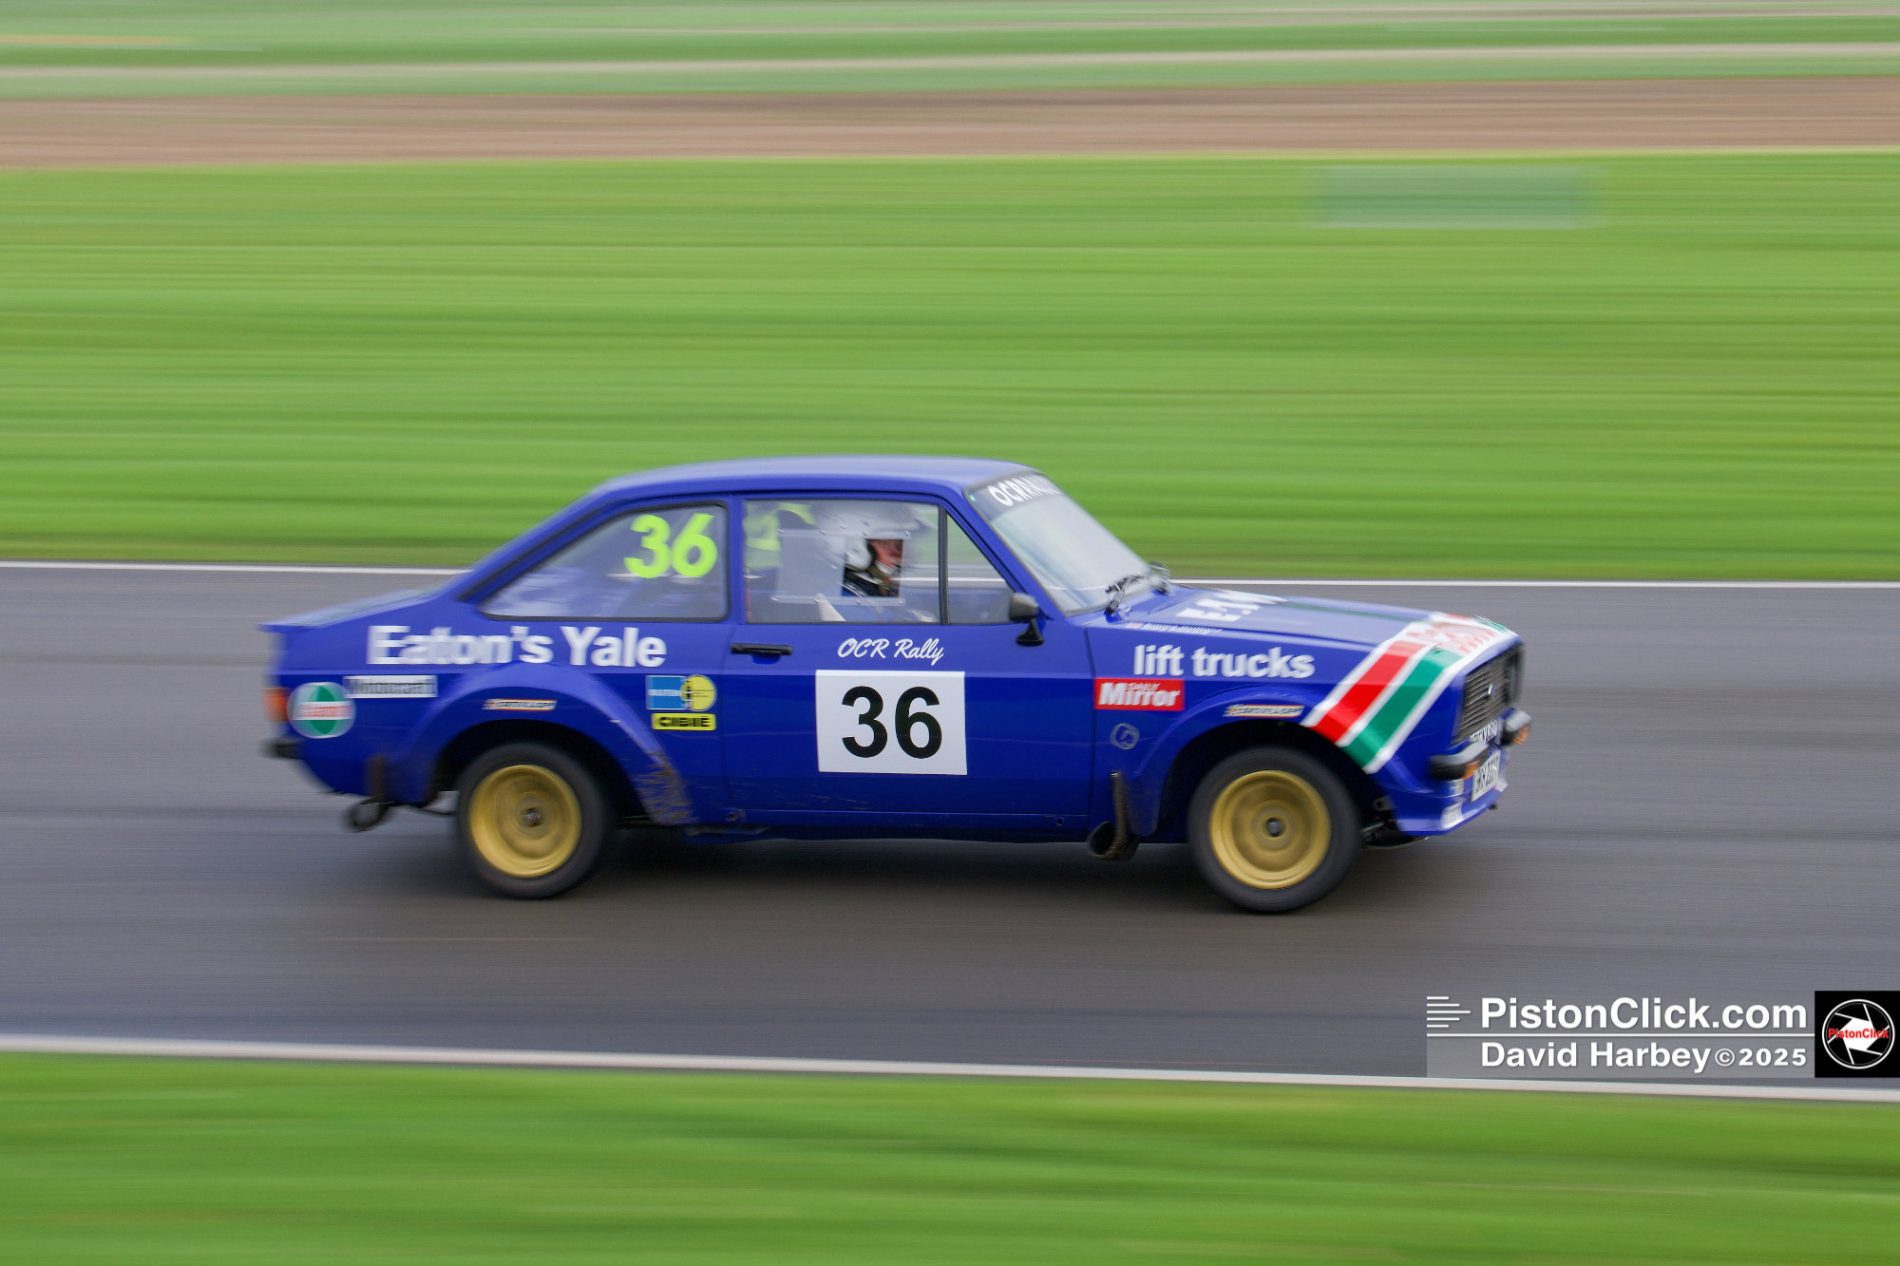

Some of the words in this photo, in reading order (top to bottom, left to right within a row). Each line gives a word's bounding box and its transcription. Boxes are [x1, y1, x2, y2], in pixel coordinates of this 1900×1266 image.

[624, 512, 718, 579] 36
[366, 625, 553, 665] Eaton's
[560, 626, 667, 668] Yale
[837, 637, 887, 660] OCR
[893, 637, 944, 666] Rally
[1133, 644, 1184, 677] lift
[1192, 646, 1316, 679] trucks
[1098, 682, 1181, 706] Mirror
[841, 685, 943, 760] 36
